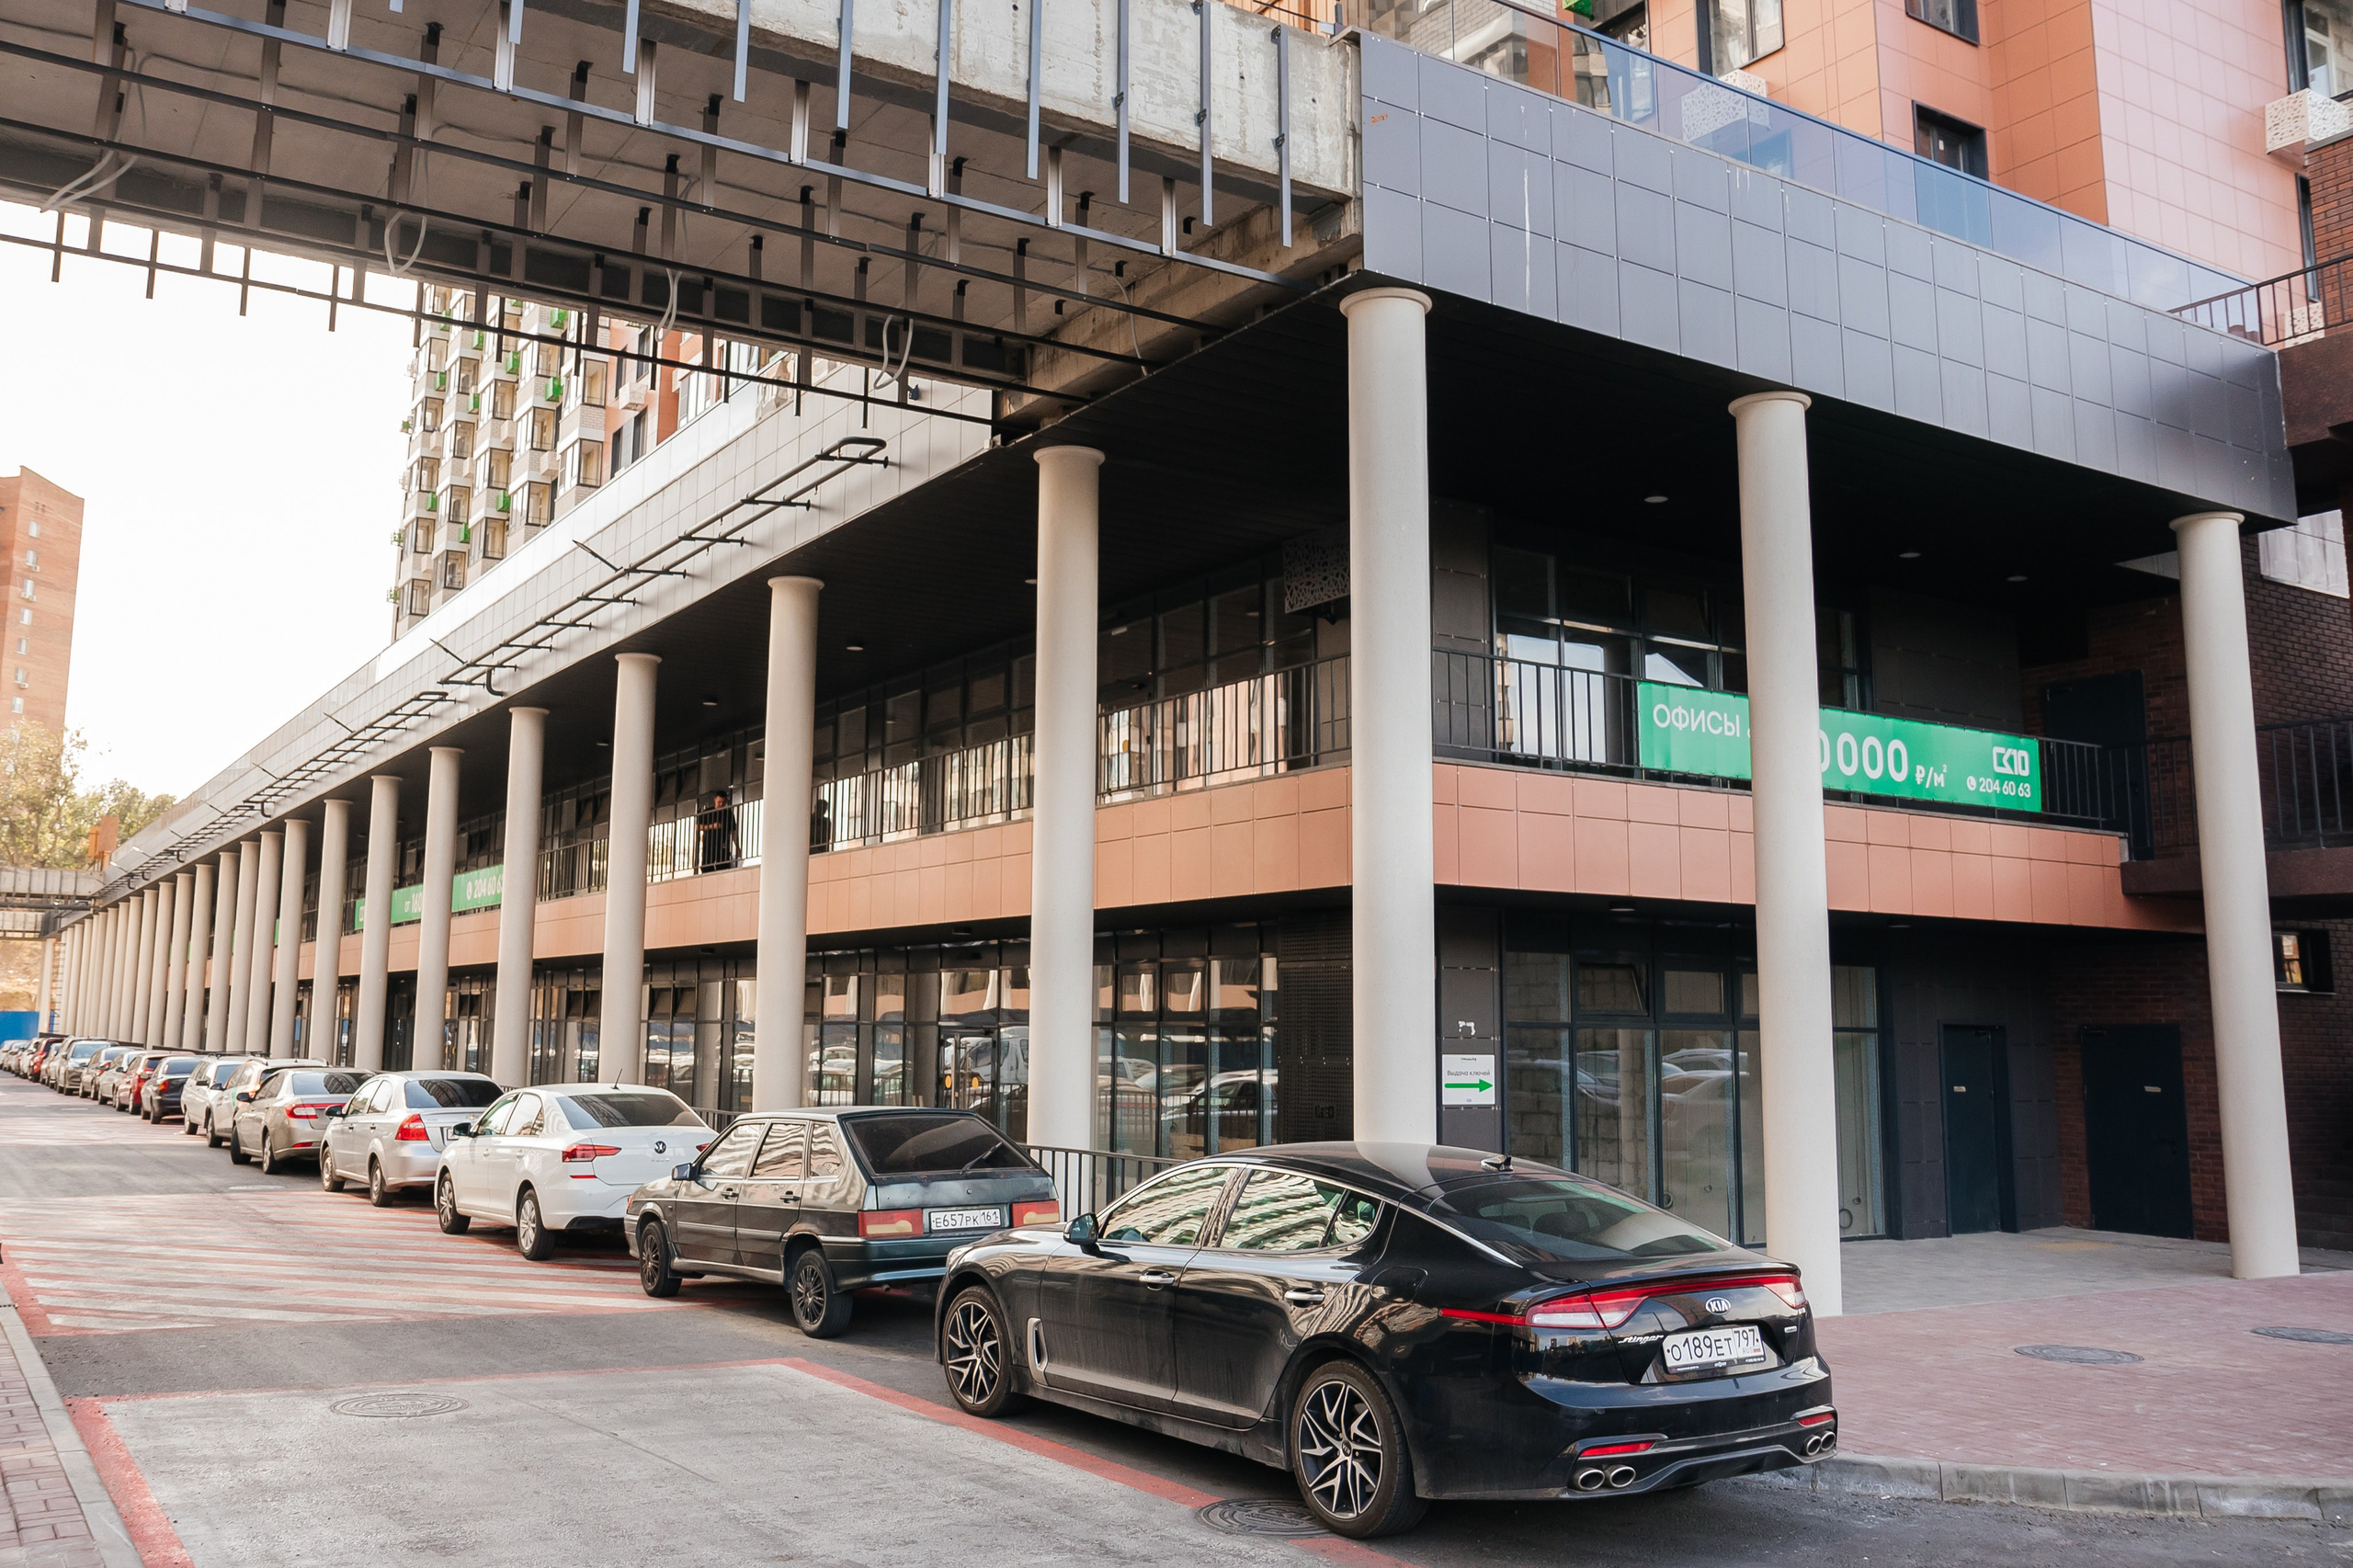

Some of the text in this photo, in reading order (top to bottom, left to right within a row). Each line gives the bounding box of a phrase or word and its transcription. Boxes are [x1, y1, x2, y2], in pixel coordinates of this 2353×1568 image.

[1653, 703, 1741, 737] ОФИСЫ
[1979, 777, 2031, 798] 204 60 63
[1446, 1069, 1469, 1077] Выдача
[1618, 1335, 1665, 1345] Stinger
